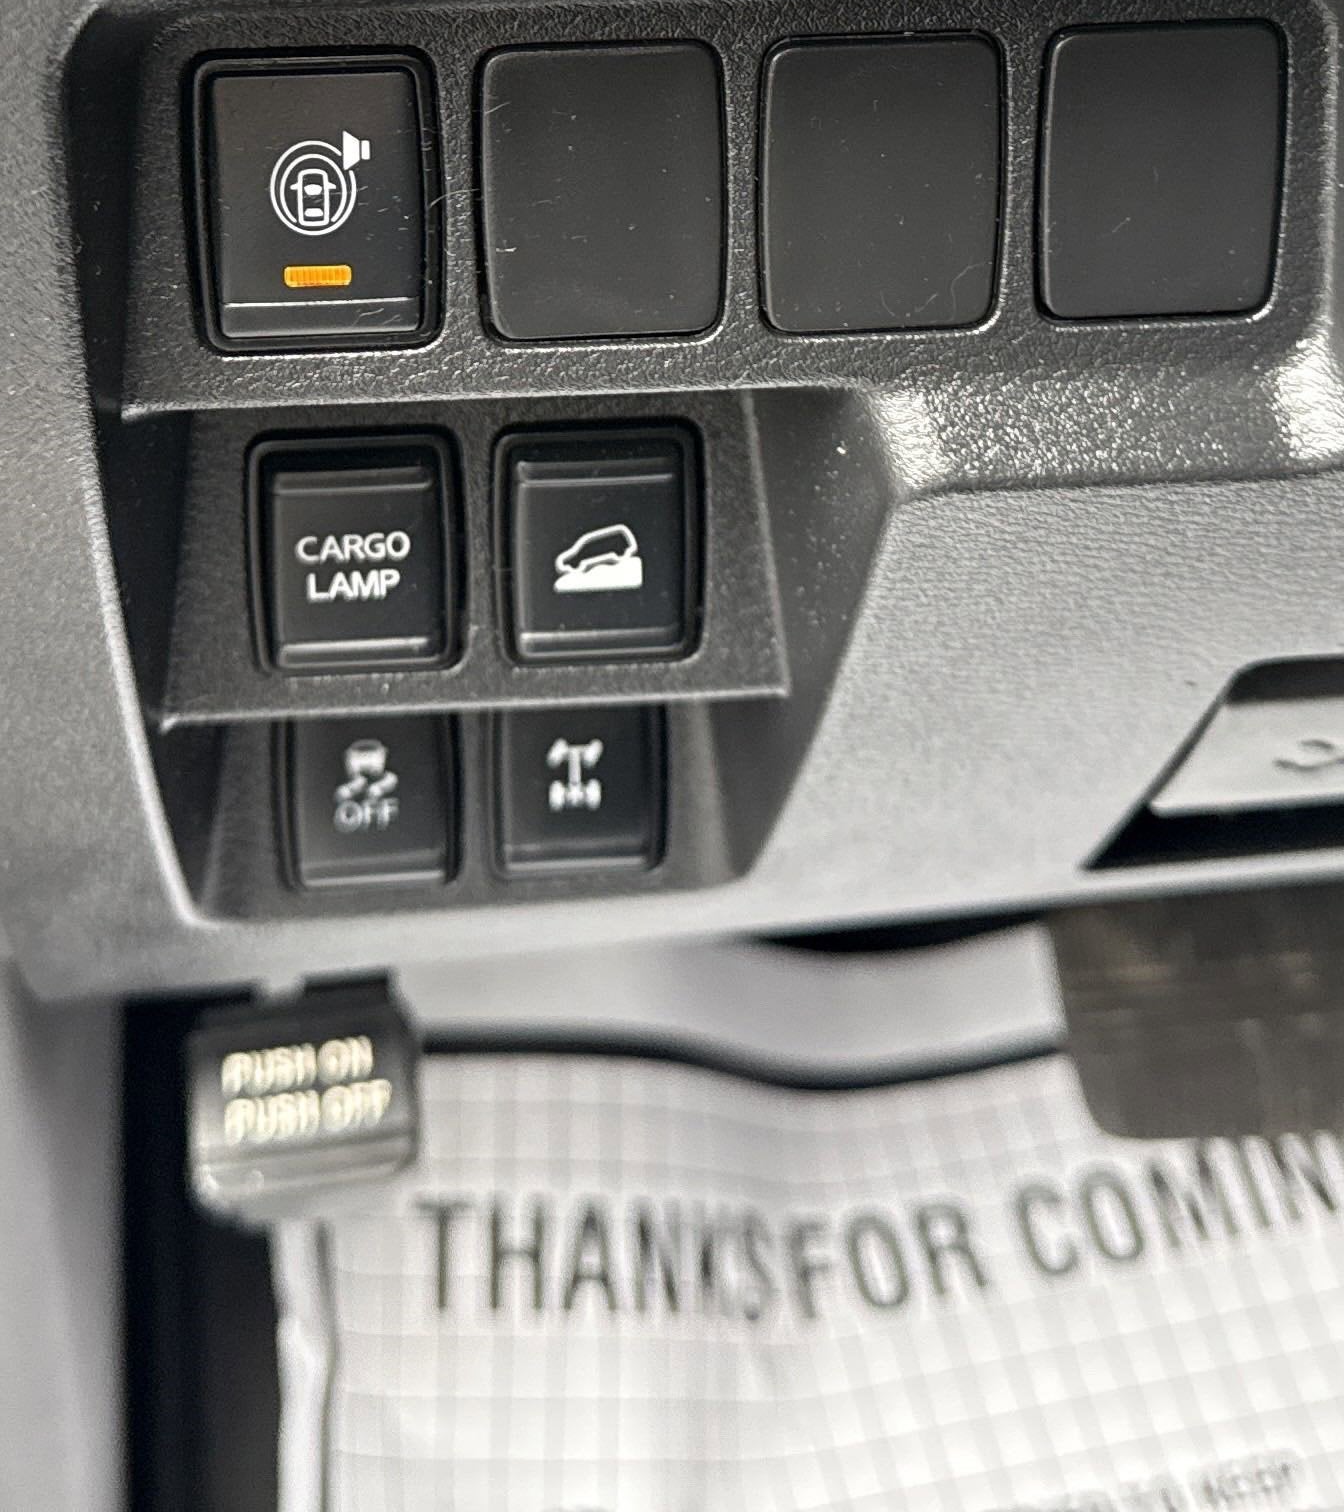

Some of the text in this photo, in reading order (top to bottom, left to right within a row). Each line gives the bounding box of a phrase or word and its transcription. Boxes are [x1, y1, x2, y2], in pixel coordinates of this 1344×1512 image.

[296, 531, 411, 564] CARGO
[307, 569, 401, 601] LAMP
[333, 797, 399, 832] OFF
